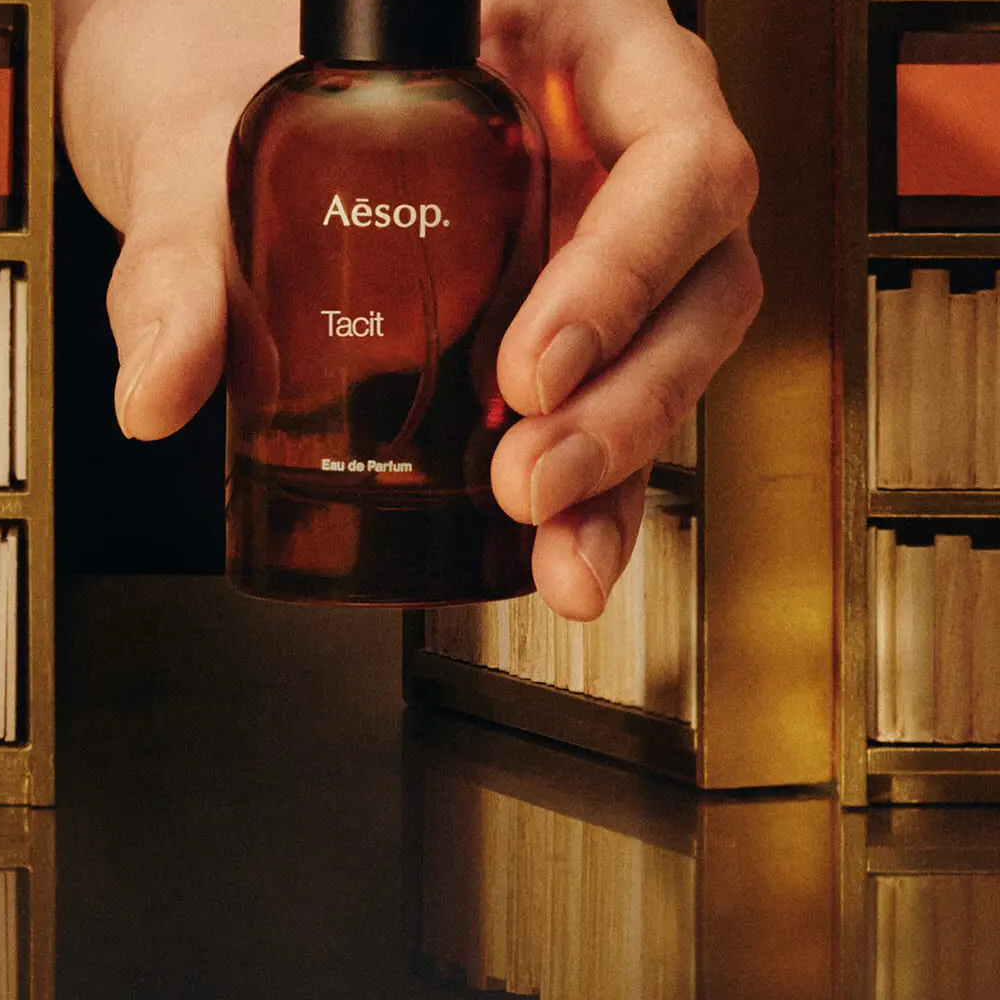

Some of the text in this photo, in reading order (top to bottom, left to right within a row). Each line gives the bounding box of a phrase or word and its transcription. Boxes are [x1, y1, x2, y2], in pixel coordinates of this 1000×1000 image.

[322, 194, 450, 238] Aēsop.
[320, 310, 385, 337] Tacit
[321, 458, 413, 473] Eau de Parfum
